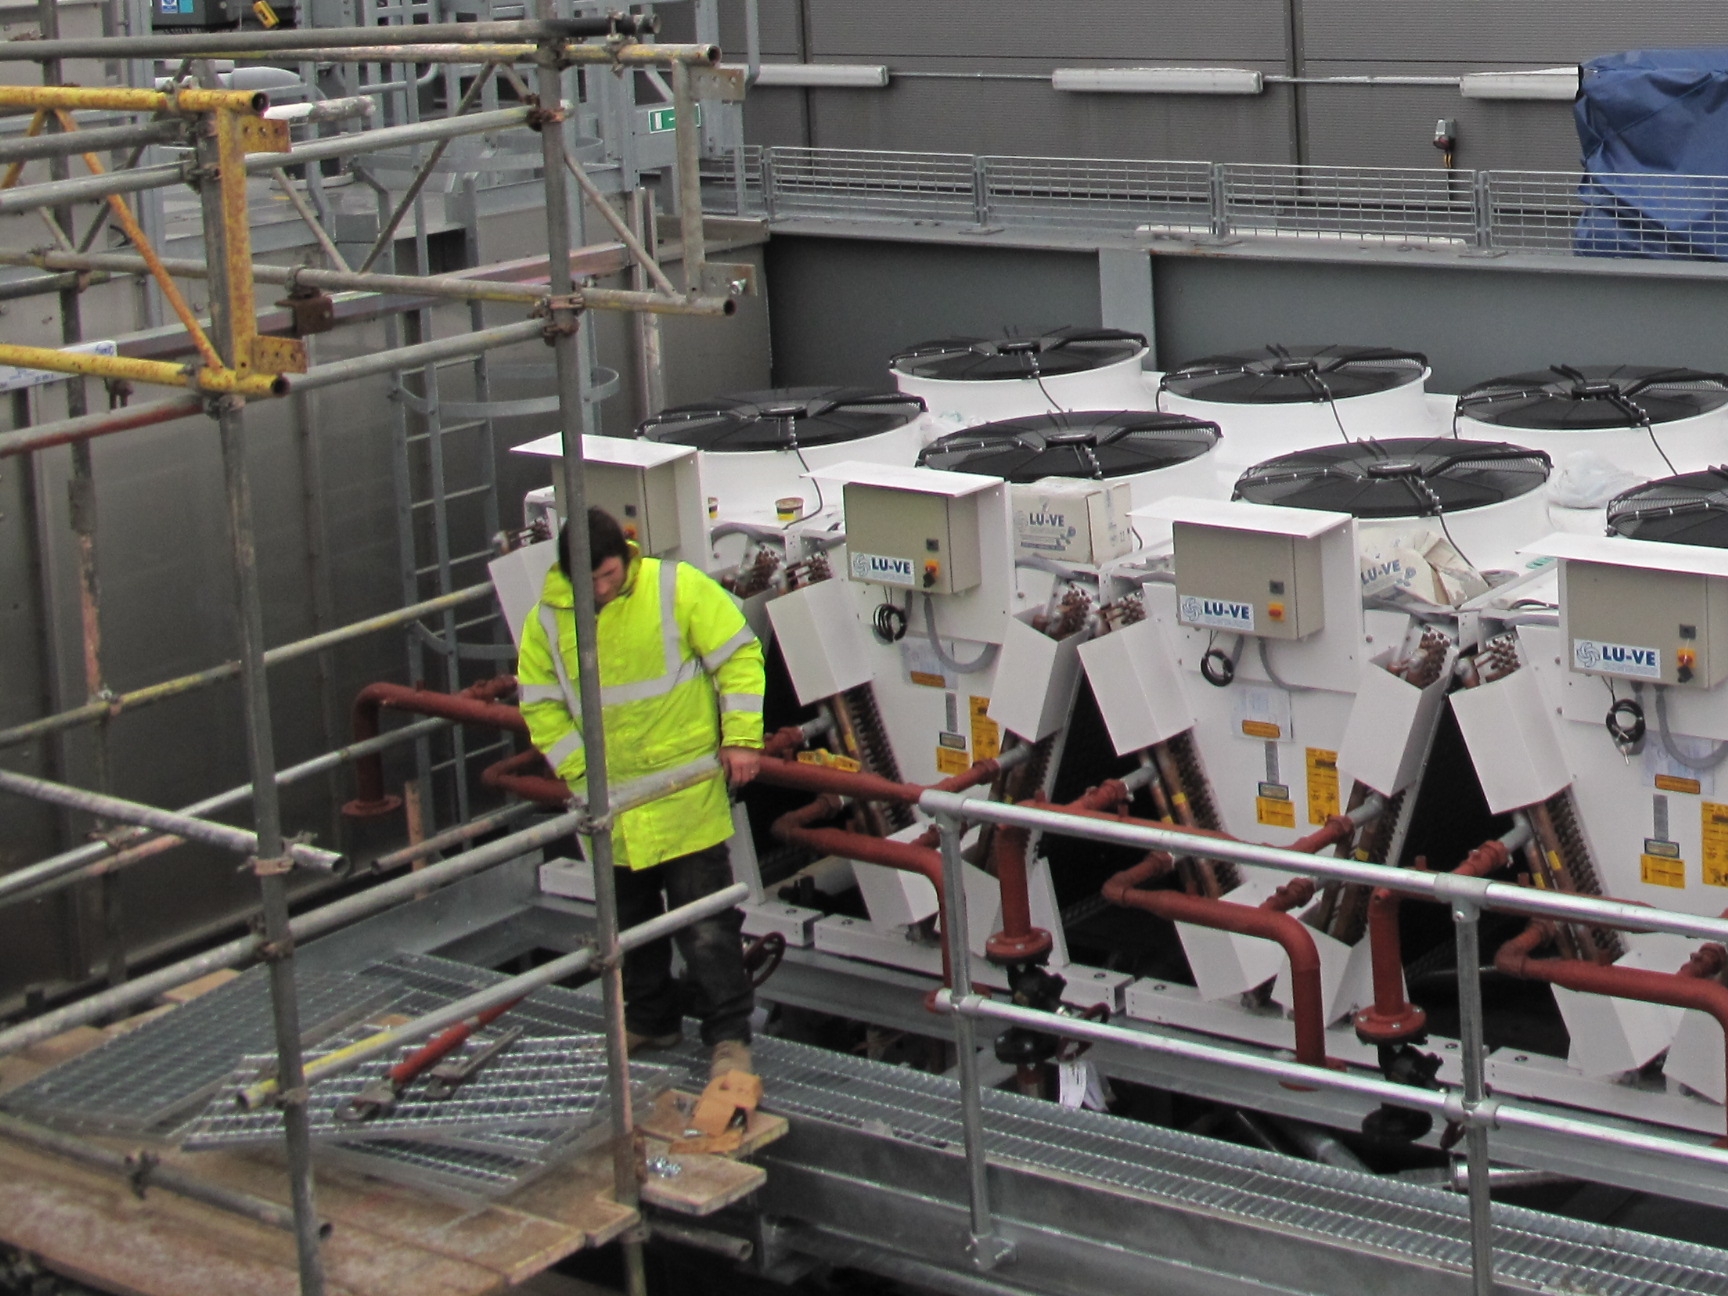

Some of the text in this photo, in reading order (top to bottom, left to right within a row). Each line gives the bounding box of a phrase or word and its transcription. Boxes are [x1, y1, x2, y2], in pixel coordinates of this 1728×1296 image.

[1029, 512, 1065, 527] LU-VE
[871, 557, 911, 576] LU-VE
[1360, 559, 1401, 585] LU-VE
[1203, 600, 1250, 620] LU-VE
[1602, 645, 1656, 667] LU-VE
